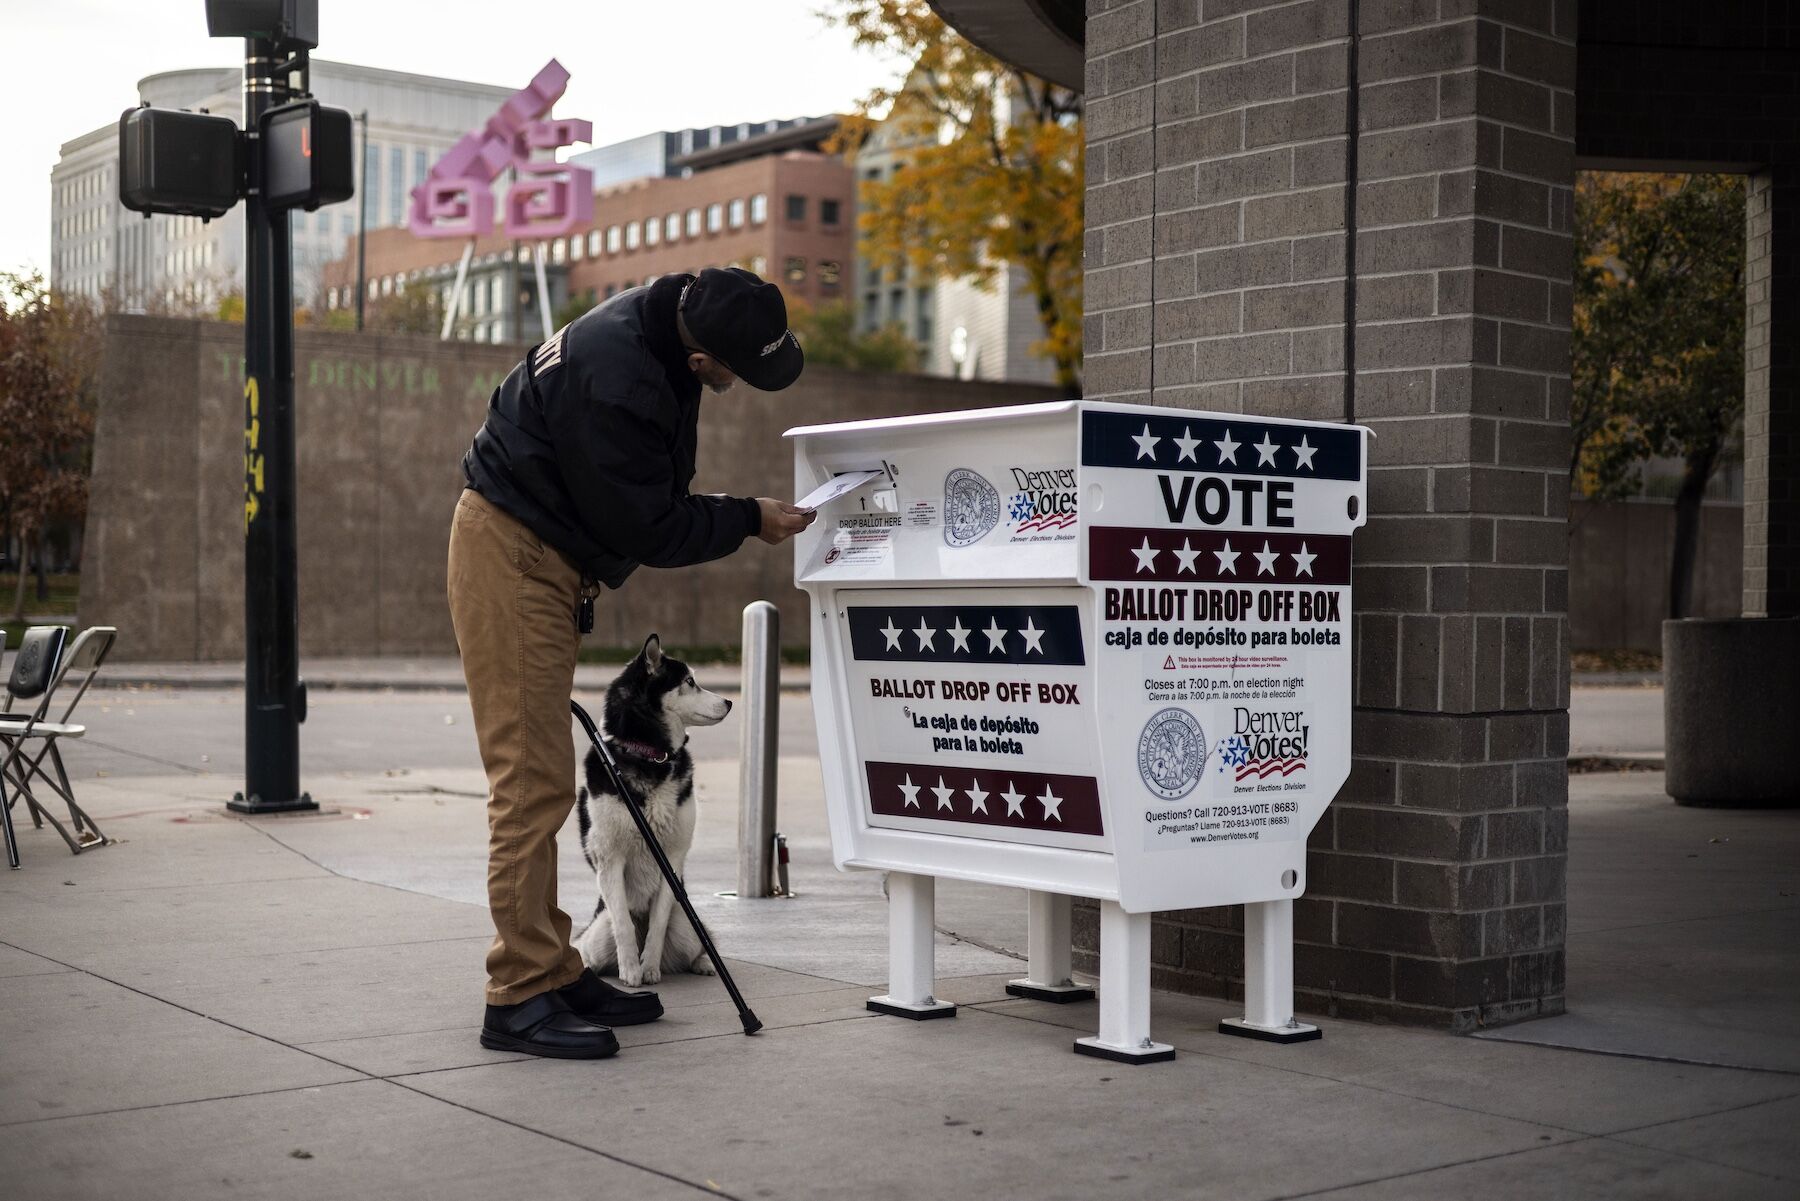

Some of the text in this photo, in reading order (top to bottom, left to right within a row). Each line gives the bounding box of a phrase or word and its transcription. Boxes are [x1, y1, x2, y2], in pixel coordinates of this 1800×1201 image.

[310, 359, 441, 393] DENVER
[1010, 467, 1077, 490] Denver
[1157, 474, 1295, 528] VOTE
[840, 517, 902, 528] DROP BALLOT HERE
[1105, 588, 1340, 622] BALLOT DROP OFF BOX
[1105, 626, 1340, 649] caja de depósito para boleta
[870, 678, 1080, 705] BALLOT DROP OFF BOX
[1144, 677, 1304, 690] Closes at 7:00 p.m. on election night
[1149, 692, 1169, 701] Cierra
[1178, 692, 1187, 700] las
[1190, 692, 1204, 700] 7:00
[1206, 692, 1221, 701] p.m.
[1230, 691, 1250, 699] noche
[1252, 691, 1260, 699] de
[1262, 690, 1268, 698] la
[1270, 690, 1295, 698] elección
[912, 712, 1039, 736] La caja de depósito
[1148, 718, 1160, 732] THE
[1161, 712, 1183, 720] CLERK
[1185, 716, 1198, 732] AND
[1234, 707, 1304, 734] Denver
[933, 736, 1023, 755] para la boleta
[1242, 726, 1309, 760] Votes!
[1257, 784, 1281, 792] Elections
[1284, 783, 1306, 791] Division
[1145, 802, 1298, 822] Questions? Call 720-913-VOTE (8683)
[1158, 816, 1290, 835] ¿Preguntas? Llame 720-913-VOTE (8683)
[1190, 831, 1259, 843] www.DenverVotes.org
